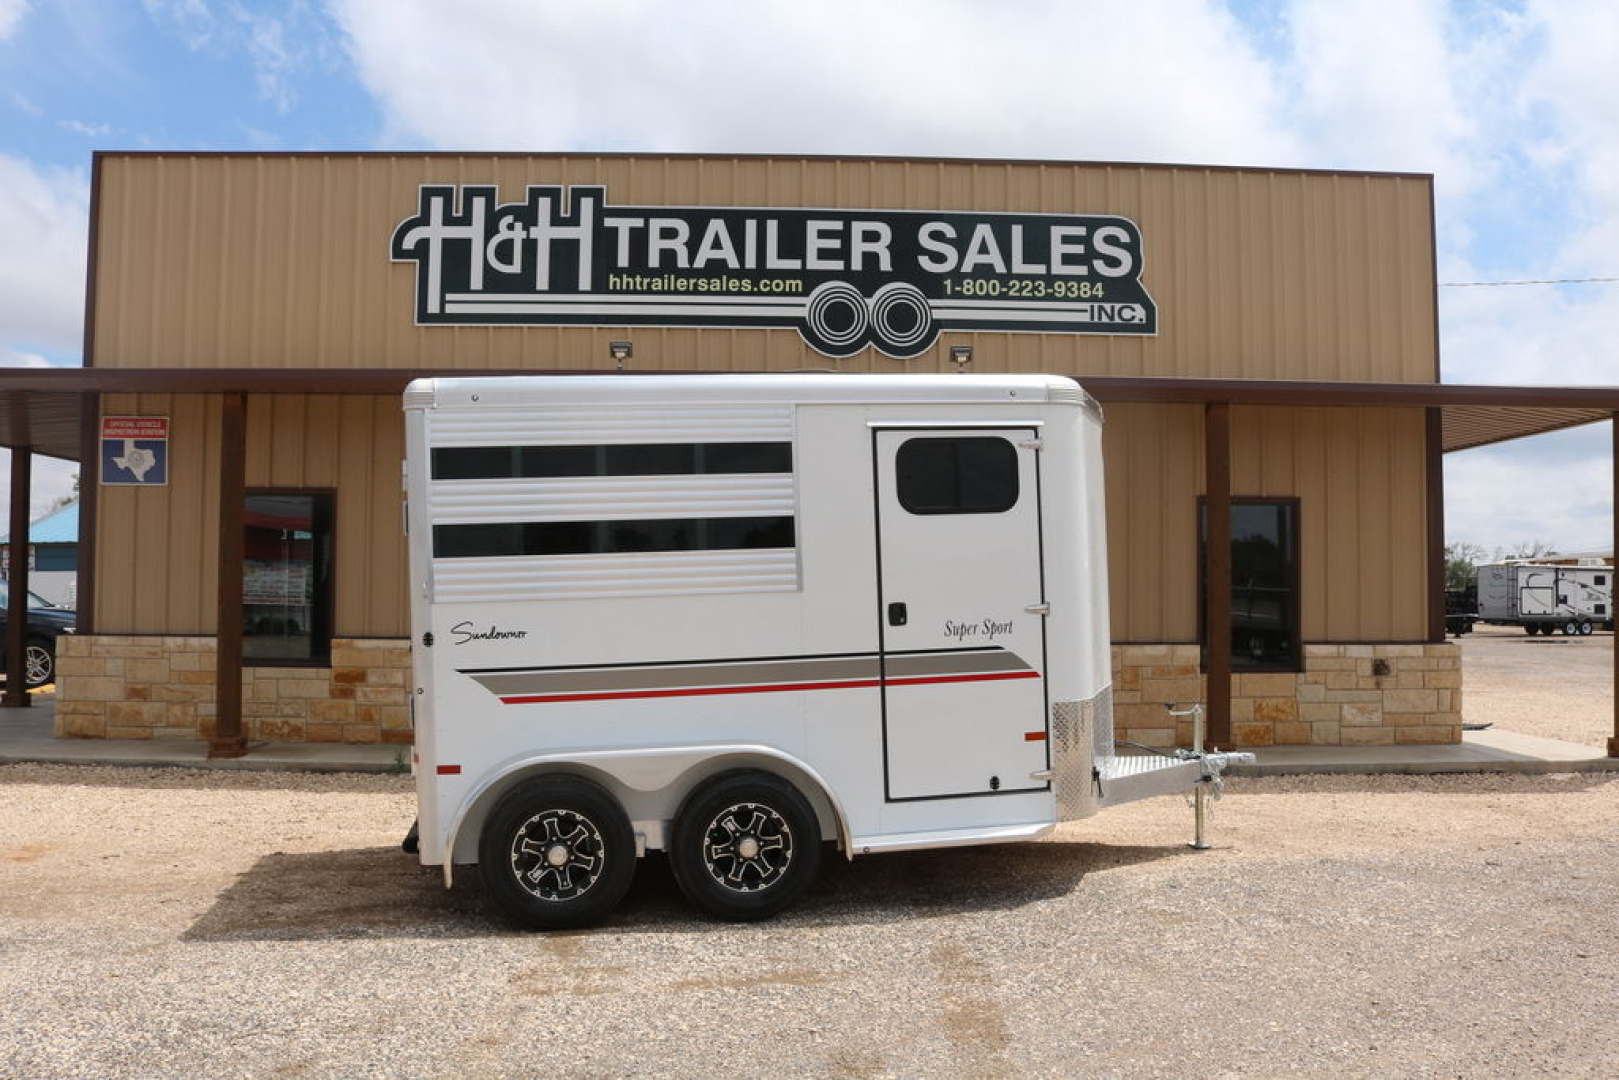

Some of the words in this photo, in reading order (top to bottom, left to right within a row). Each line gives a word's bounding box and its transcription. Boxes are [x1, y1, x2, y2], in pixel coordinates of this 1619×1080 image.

[402, 197, 594, 314] H&H
[603, 217, 893, 272] TRAILER
[917, 221, 1133, 278] SALES
[609, 273, 803, 293] hhtrailersales.com
[943, 278, 1105, 298] 1-800-223-9384
[1089, 304, 1145, 323] INC.
[943, 619, 979, 641] Super
[982, 617, 1013, 640] Sport
